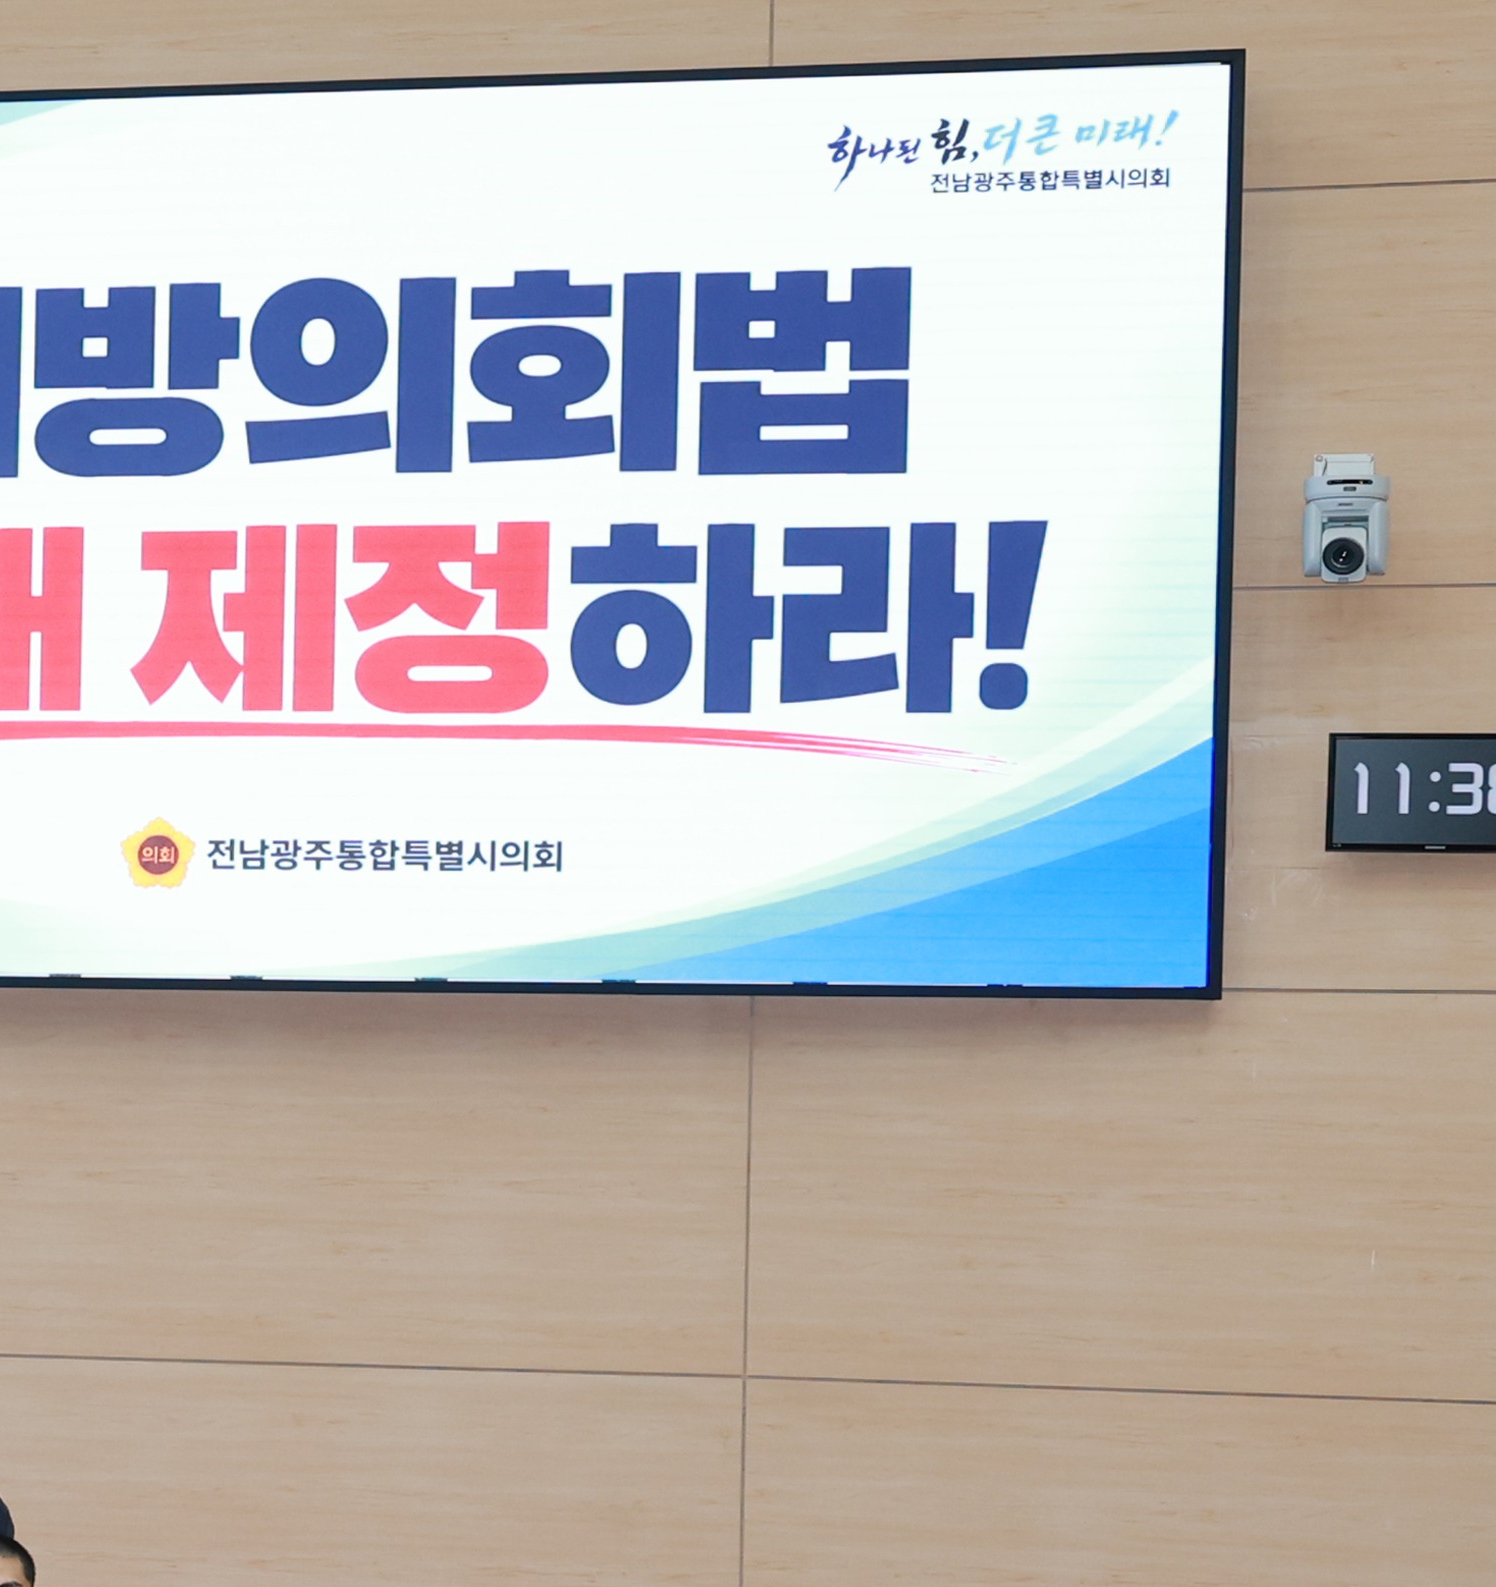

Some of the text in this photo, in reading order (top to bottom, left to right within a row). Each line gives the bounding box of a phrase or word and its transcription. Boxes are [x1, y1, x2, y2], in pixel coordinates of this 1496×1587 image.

[827, 124, 921, 191] 하나된
[982, 117, 1022, 166] 더
[1025, 113, 1063, 156] 큰
[1074, 109, 1180, 150] 미래!
[930, 167, 1171, 194] 전남광주통합특별시의회
[130, 519, 1049, 715] 제정하라!
[1353, 762, 1496, 815] 11:3
[141, 845, 176, 865] 의회
[207, 838, 563, 873] 전남광주통합특별시의회
